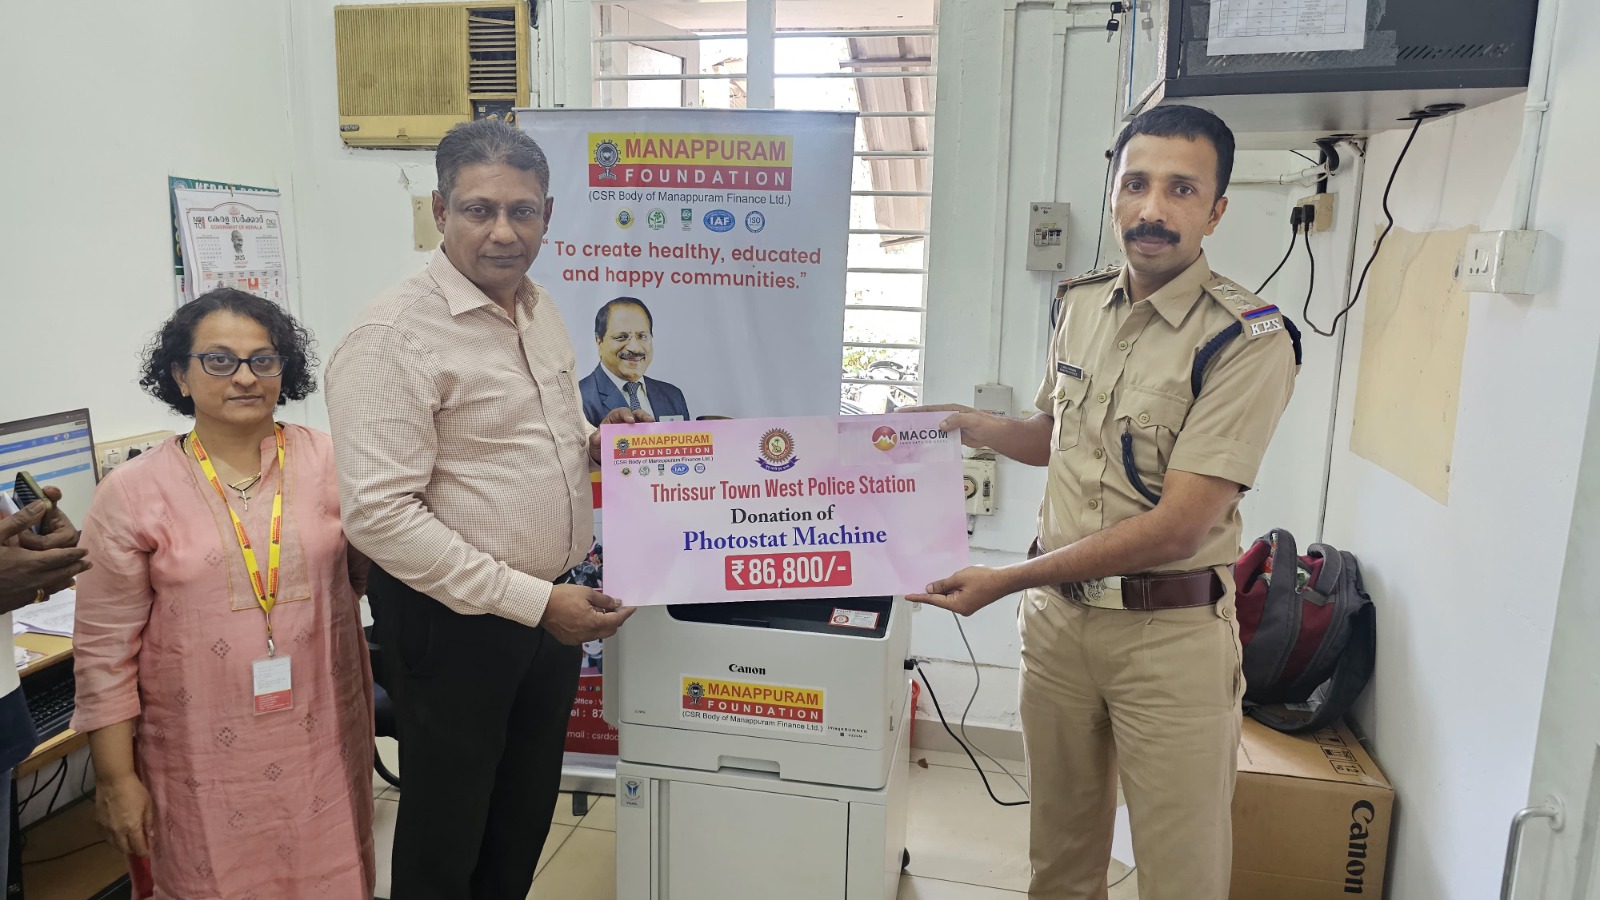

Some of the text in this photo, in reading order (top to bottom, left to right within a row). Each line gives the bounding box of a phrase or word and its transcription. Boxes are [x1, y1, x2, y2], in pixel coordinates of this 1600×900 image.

[625, 138, 786, 162] MANAPPURAM
[625, 168, 785, 186] FOUNDATION
[588, 190, 791, 206] (CSR Body of Manappuram Finance Ltd.)
[710, 216, 731, 226] IAF
[555, 241, 576, 257] To
[582, 243, 642, 257] create
[648, 241, 725, 265] healthy,
[731, 245, 821, 265] educated
[562, 266, 807, 289] and happy communities.”
[631, 434, 709, 446] MANAPPURAM
[899, 429, 948, 441] MACOM
[631, 447, 710, 456] FOUNDATION
[651, 474, 916, 502] Thrissur Town West Police Station
[730, 504, 835, 525] Donation of
[683, 525, 887, 551] Photostat Machine
[728, 663, 766, 676] Canon
[708, 682, 819, 706] MANAPPURAM
[570, 708, 580, 717] el
[708, 700, 818, 720] FOUNDATION
[682, 710, 701, 719] (CSR
[702, 712, 721, 723] Body
[730, 715, 776, 727] Manappuram
[777, 720, 805, 730] Finance
[806, 723, 824, 733] Ltd.)
[567, 730, 585, 738] mail
[1343, 799, 1375, 894] Canon
